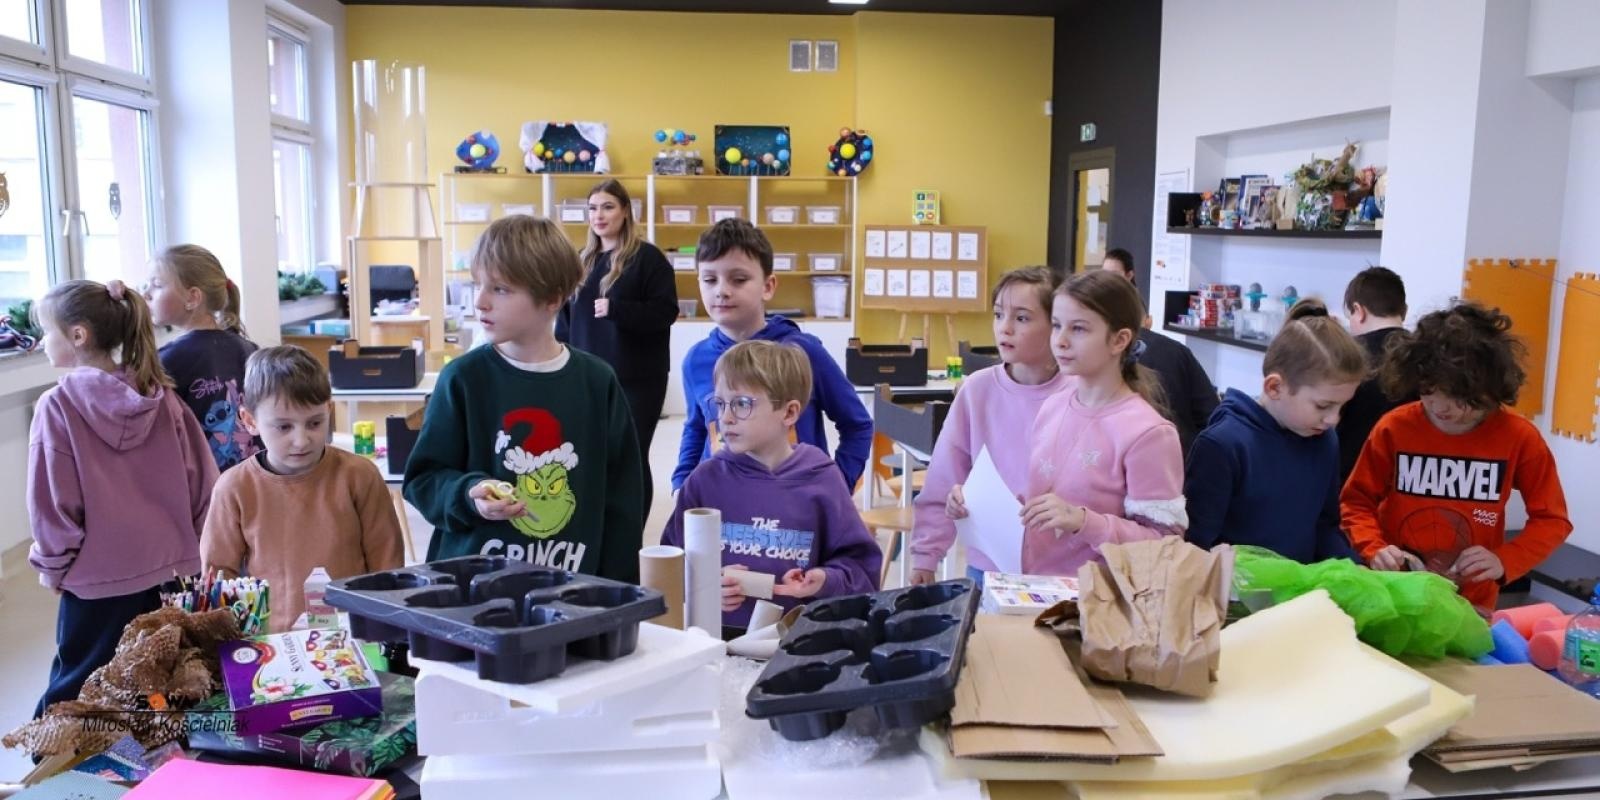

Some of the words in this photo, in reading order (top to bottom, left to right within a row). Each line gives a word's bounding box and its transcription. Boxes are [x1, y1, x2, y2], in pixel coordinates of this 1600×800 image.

[1397, 454, 1500, 501] MARVEL
[751, 517, 780, 531] THE
[729, 541, 762, 557] YOUR
[765, 546, 810, 560] CHOICE
